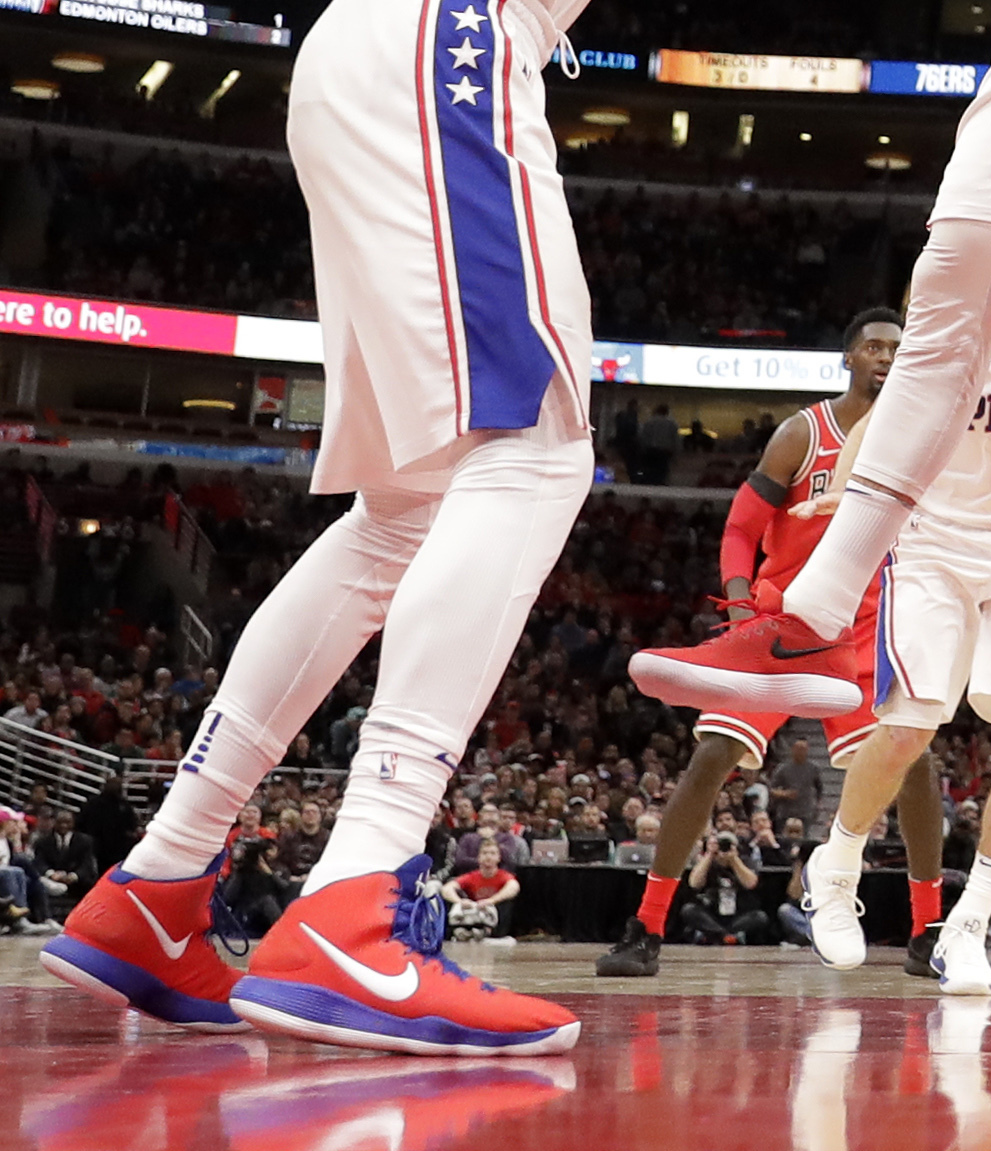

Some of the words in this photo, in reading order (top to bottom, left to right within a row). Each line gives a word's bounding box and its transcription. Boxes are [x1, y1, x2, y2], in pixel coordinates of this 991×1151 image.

[59, 0, 149, 29] EDMONTON
[150, 14, 208, 36] OILERS
[579, 50, 637, 70] CLUB
[915, 63, 977, 94] 76ERS
[42, 302, 73, 329] to
[79, 302, 148, 342] help.
[696, 355, 741, 378] Get
